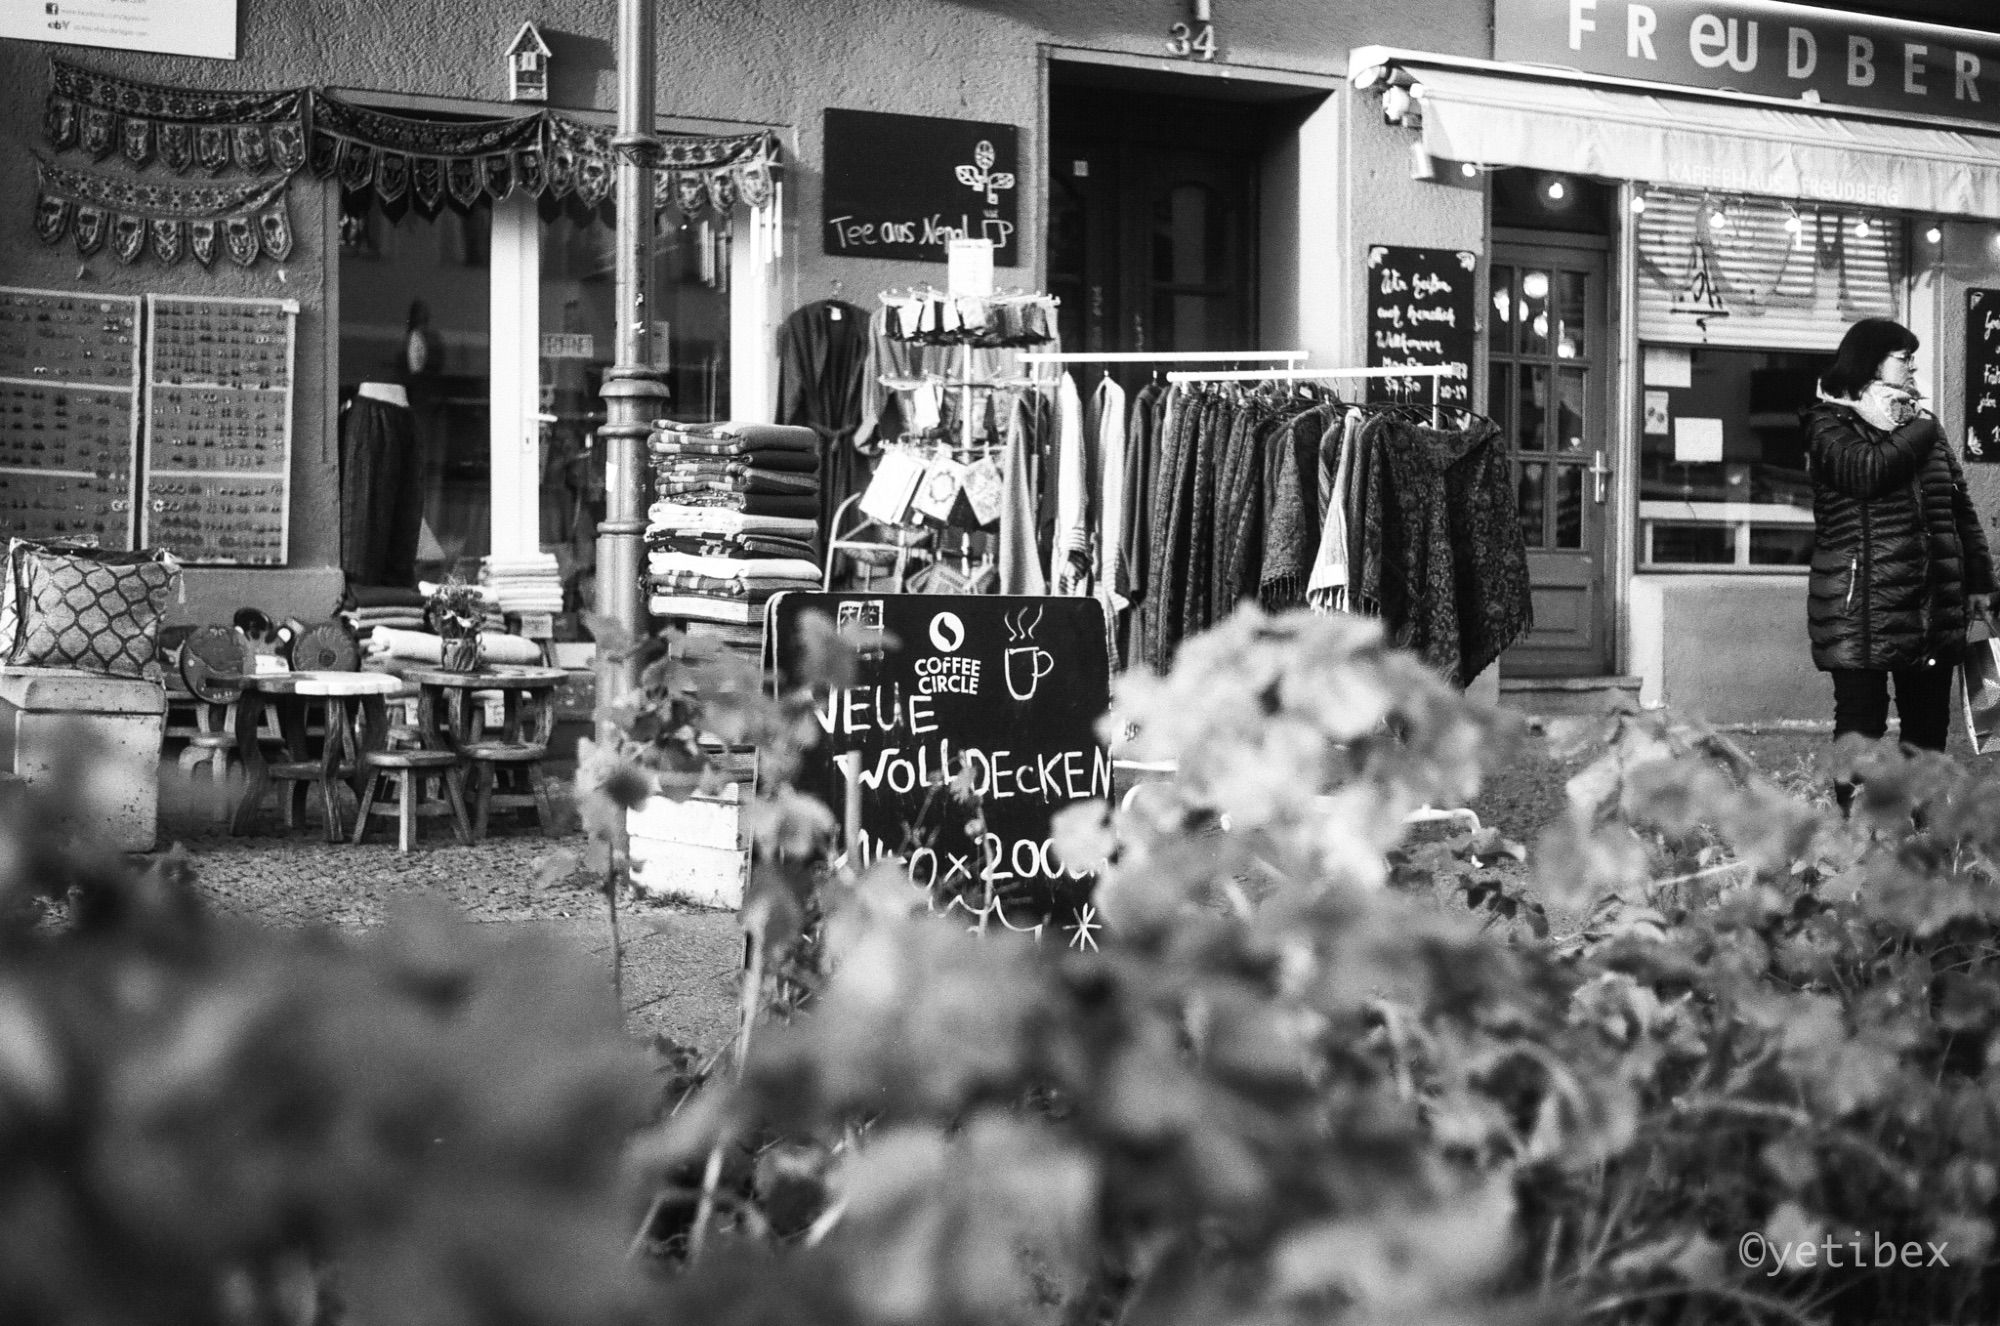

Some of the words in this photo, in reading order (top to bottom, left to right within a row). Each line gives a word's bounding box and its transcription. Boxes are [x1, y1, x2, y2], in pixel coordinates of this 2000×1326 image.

[1166, 22, 1218, 60] 34
[829, 215, 877, 249] Tee
[881, 221, 916, 244] aus
[914, 656, 981, 678] COFFEE
[918, 674, 979, 696] CIRCLE
